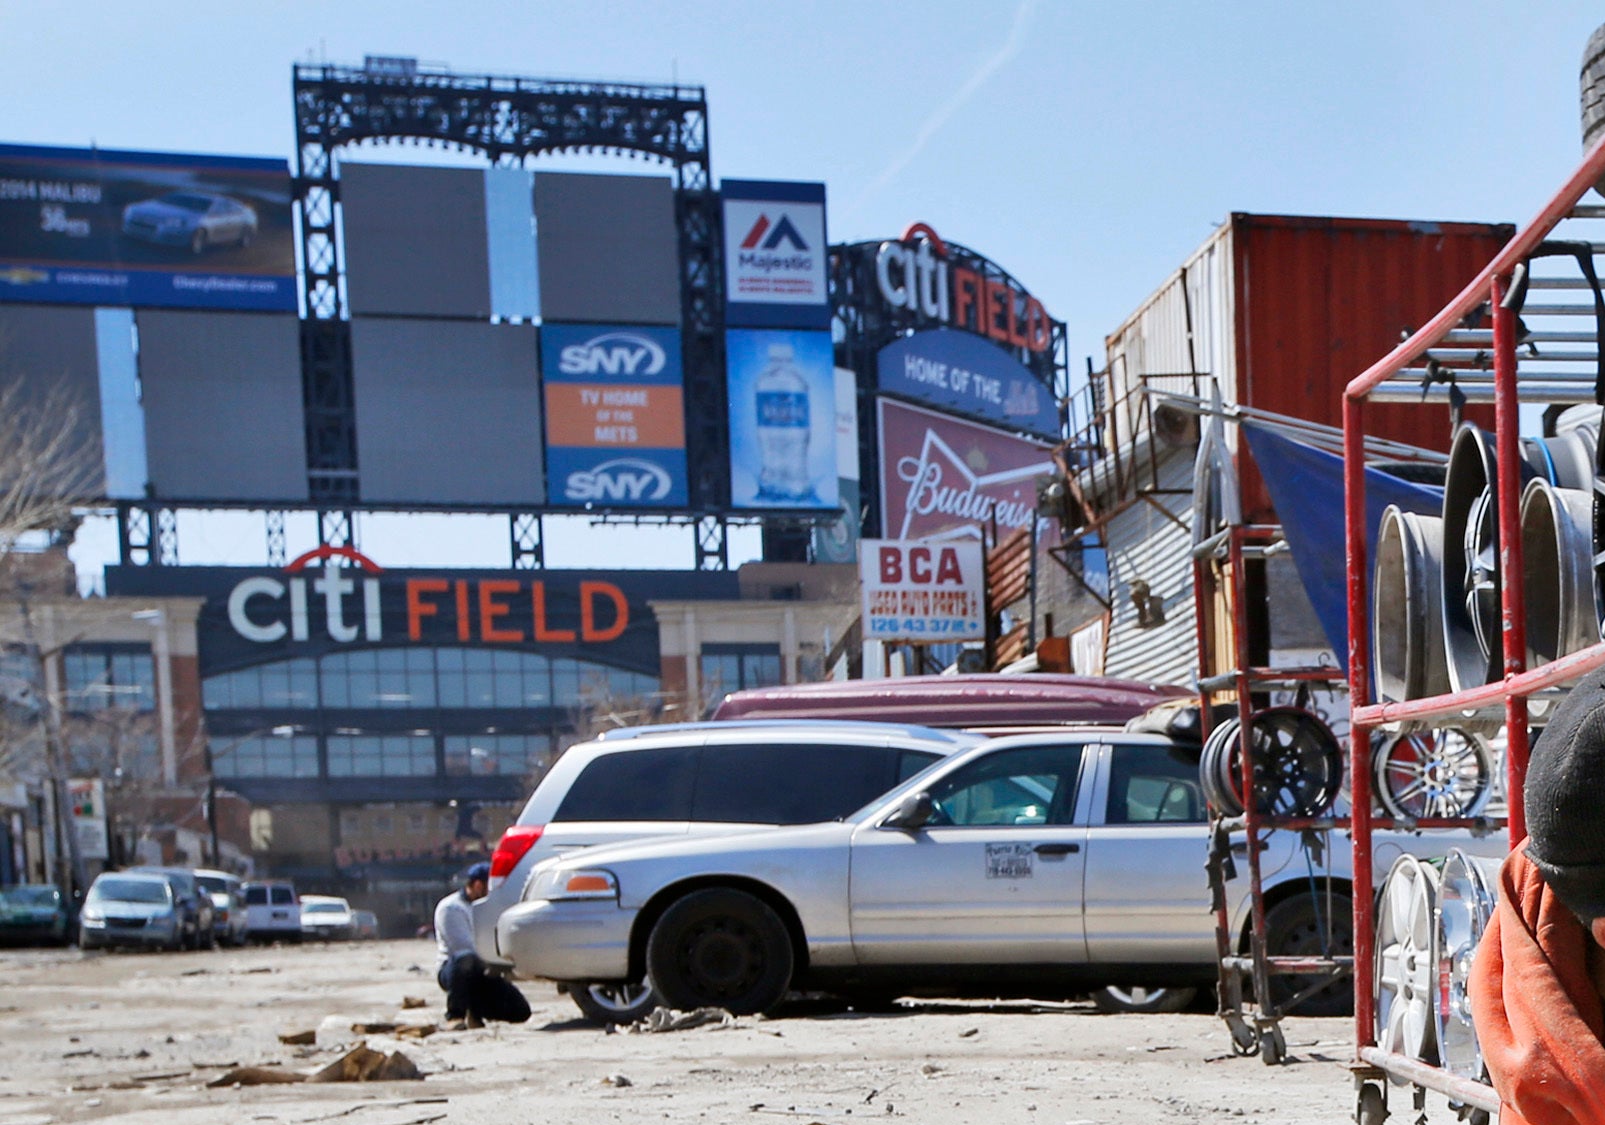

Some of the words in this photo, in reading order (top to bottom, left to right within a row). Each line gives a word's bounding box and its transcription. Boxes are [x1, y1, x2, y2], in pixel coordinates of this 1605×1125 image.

[739, 252, 812, 274] Majestic
[955, 266, 1050, 352] FIELD
[559, 341, 656, 375] SNY
[904, 354, 948, 388] HOME
[950, 366, 970, 394] OF
[973, 372, 1002, 404] THE
[580, 389, 599, 406] TV
[603, 390, 649, 407] HOME
[594, 426, 638, 442] METS
[565, 467, 660, 500] SNY
[898, 457, 1050, 546] Budweiser
[879, 547, 963, 585] BCA
[406, 579, 629, 642] FIELD
